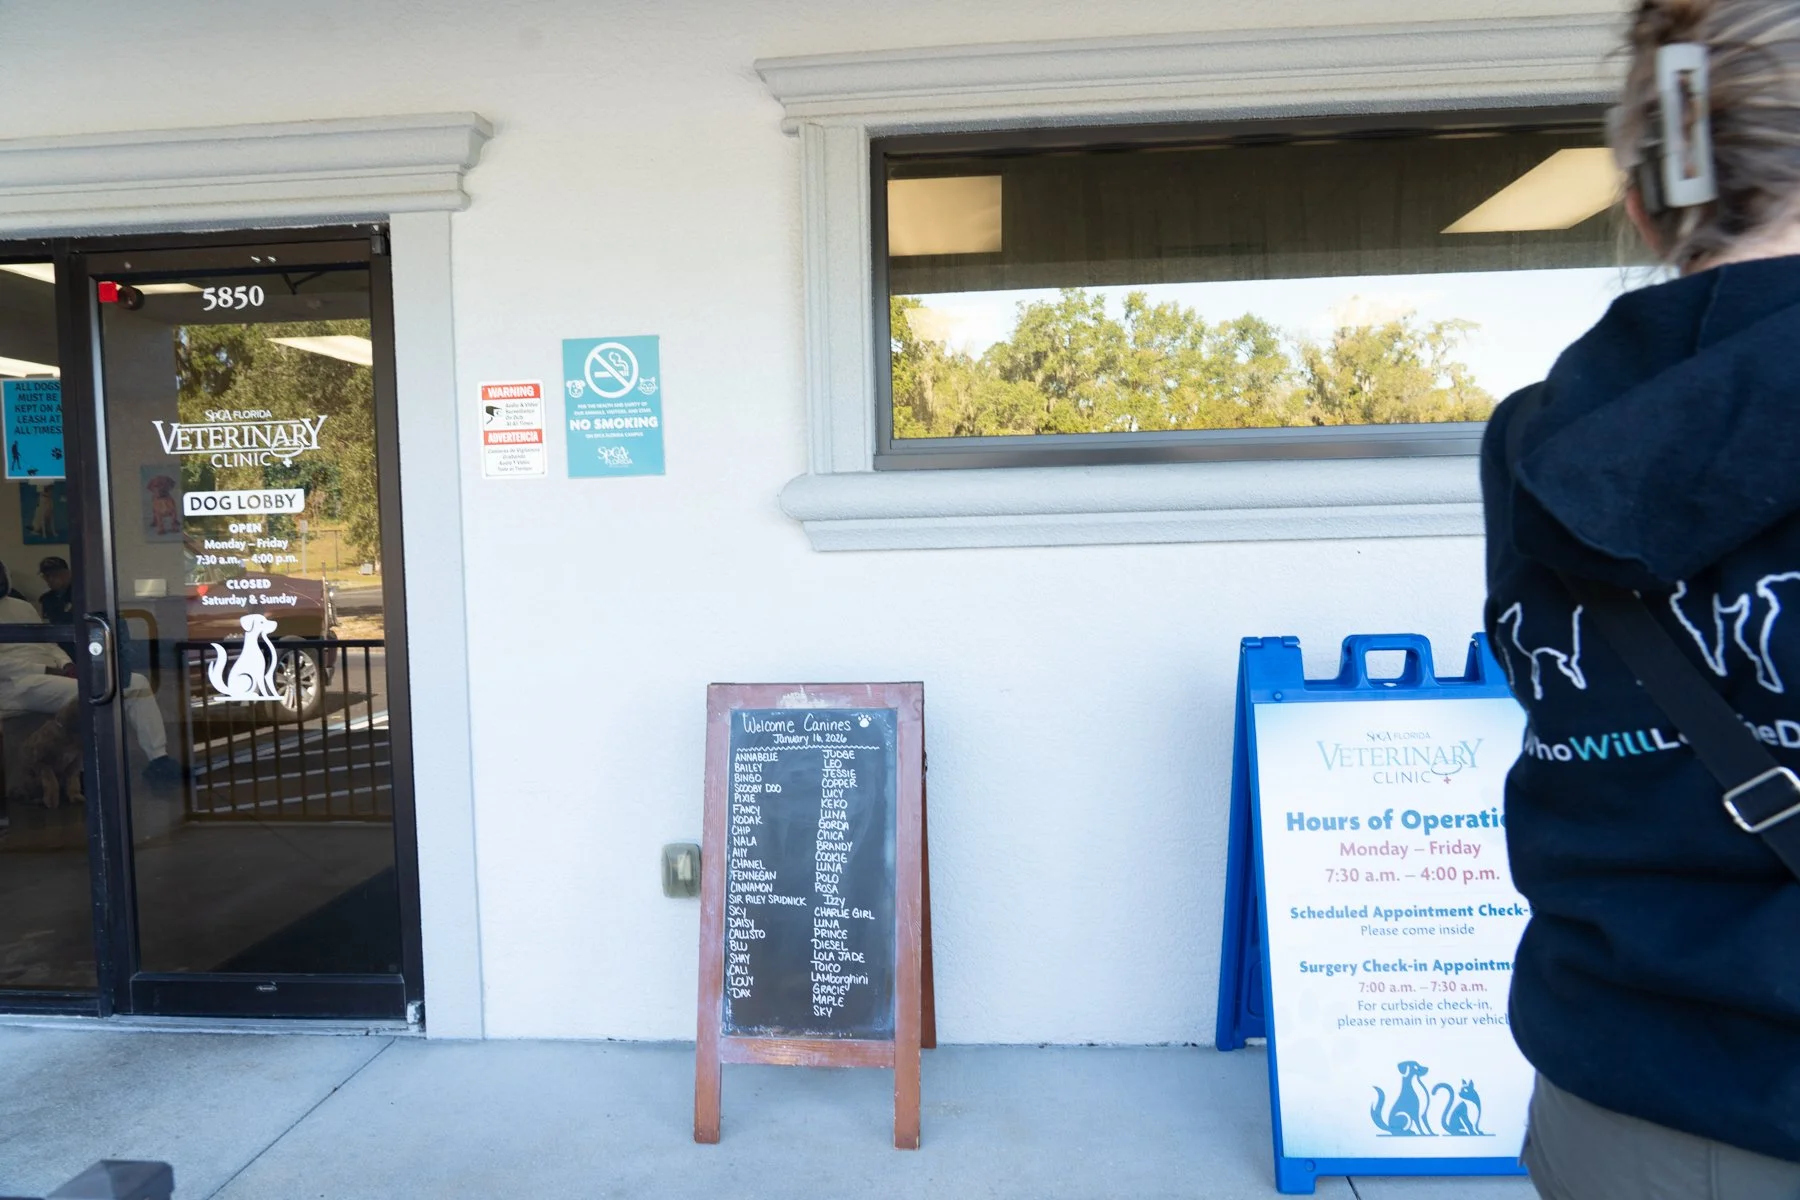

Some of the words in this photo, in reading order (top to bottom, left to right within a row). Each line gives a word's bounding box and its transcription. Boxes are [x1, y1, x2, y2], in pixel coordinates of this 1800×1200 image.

[202, 285, 264, 311] 5850
[15, 382, 32, 391] ALL
[35, 382, 60, 390] DOGS
[488, 386, 534, 398] WARNING
[18, 393, 44, 401] MUST
[46, 393, 57, 401] BE
[15, 404, 37, 412] KEPT
[40, 404, 52, 412] ON
[55, 404, 63, 412] A
[233, 409, 272, 418] FLORIDA
[17, 415, 46, 423] LEASH
[49, 415, 61, 423] AT
[570, 419, 591, 430] NO
[594, 416, 658, 429] SMOKING
[15, 426, 31, 435] ALL
[152, 415, 328, 454] VETERINARY
[488, 431, 539, 443] ADVERTENCIA
[211, 452, 271, 468] CLINIC
[191, 496, 232, 511] DOG
[238, 494, 296, 509] LOBBY
[229, 524, 262, 533] OPEN
[204, 540, 246, 551] Monday
[257, 538, 288, 550] Friday
[196, 555, 216, 564] 7:30
[218, 556, 240, 564] a.m.
[252, 554, 273, 563] 4:00
[276, 555, 298, 565] p.m.
[226, 580, 271, 589] CLOSED
[202, 594, 247, 607] Saturday
[249, 595, 258, 604] &
[260, 593, 297, 606] Sunday
[743, 712, 795, 733] Welcome
[804, 713, 851, 731] Canines
[772, 733, 809, 746] January
[825, 733, 848, 743] 2026
[1394, 732, 1430, 740] FLORIDA
[735, 752, 778, 762] ANNABELLE
[823, 750, 855, 759] JUDGE
[1317, 739, 1484, 771] VETERINARY
[734, 763, 762, 772] BAILEY
[824, 759, 842, 769] LEO
[734, 774, 762, 782] BINGO
[822, 769, 856, 778] JESSIE
[1374, 771, 1431, 784] CLINIC
[734, 784, 762, 792] SCOOBY
[766, 784, 781, 793] DOO
[822, 778, 857, 788] COPPER
[734, 794, 755, 802] PIXIE
[822, 789, 843, 798] LUCY
[733, 804, 760, 815] FANCY
[821, 799, 847, 809] KEKO
[820, 809, 846, 820] LUNA
[1286, 811, 1360, 831] Hours
[1368, 809, 1394, 830] of
[733, 816, 762, 825] KODAK
[818, 819, 849, 830] GORDA
[732, 826, 750, 835] CHIP
[733, 837, 757, 846] NALA
[816, 841, 853, 852] BRANDY
[1340, 841, 1409, 859] Monday
[1430, 839, 1481, 859] Friday
[815, 851, 847, 863] COOKIE
[731, 858, 766, 870] CHANEL
[816, 862, 842, 873] LUNA
[732, 871, 776, 880] FENNEGAN
[816, 872, 839, 883] POLO
[1326, 868, 1359, 882] 7:30
[1365, 870, 1400, 882] a.m.
[1421, 867, 1456, 880] 4:00
[1463, 868, 1500, 884] p.m.
[731, 882, 772, 893] CINNAMON
[815, 883, 838, 894] ROSA
[729, 895, 743, 904] SIR
[746, 895, 766, 904] RILEY
[768, 895, 807, 906] SPUDNICK
[814, 907, 849, 918] CHARLIE
[852, 908, 875, 919] GIRL
[1291, 906, 1368, 919] Scheduled
[1373, 904, 1474, 921] Appointment
[1478, 904, 1534, 917] Check-
[814, 918, 839, 928] LUNA
[729, 929, 766, 939] CALLISTO
[814, 928, 848, 939] PRINCE
[1361, 925, 1399, 936] Please
[1403, 927, 1435, 935] come
[1439, 924, 1474, 934] inside
[811, 939, 848, 951] DIESEL
[730, 953, 750, 965] SHAY
[813, 951, 834, 961] LOLA
[838, 952, 865, 963] JADE
[729, 965, 748, 975] CALI
[1300, 961, 1358, 976] Surgery
[1363, 960, 1428, 972] Check-in
[813, 984, 845, 995] GRACIE
[1358, 982, 1385, 993] 7:00
[1389, 984, 1416, 992] a.m.
[1431, 981, 1456, 992] 7:30
[1461, 983, 1487, 992] a.m.
[730, 988, 751, 999] DAX
[813, 995, 844, 1007] MAPLE
[1358, 1001, 1377, 1011] For
[1381, 1000, 1433, 1010] curbside
[1438, 999, 1492, 1010] check-in,
[813, 1005, 832, 1017] SKY
[1337, 1016, 1376, 1029] please
[1380, 1016, 1421, 1026] remain
[1425, 1015, 1436, 1025] in
[1440, 1016, 1468, 1028] your
[1473, 1014, 1510, 1025] vehicl
